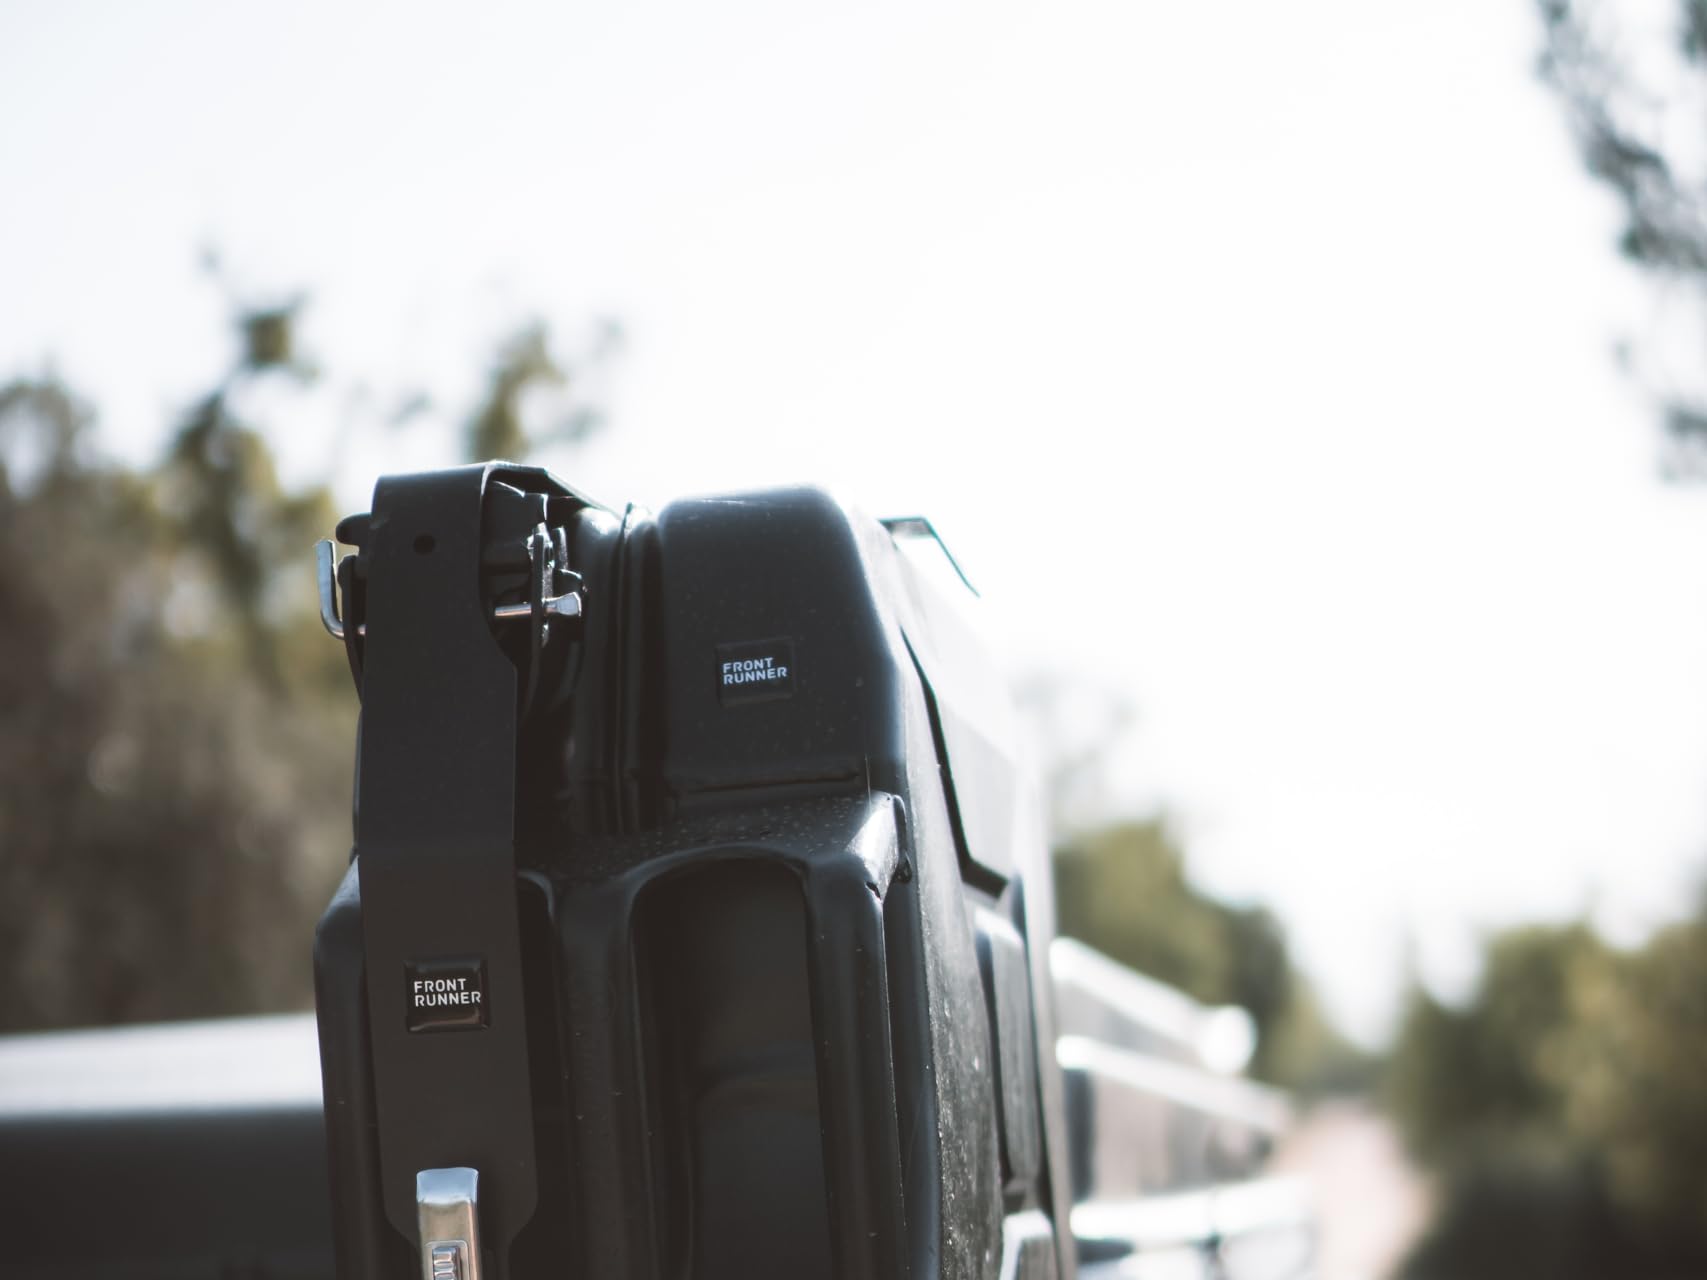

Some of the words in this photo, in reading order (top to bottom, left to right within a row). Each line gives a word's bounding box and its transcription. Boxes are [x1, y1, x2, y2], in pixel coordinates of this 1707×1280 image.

[722, 657, 774, 674] FRONT
[723, 666, 788, 685] RUNNER
[414, 978, 467, 994] FRONT
[414, 991, 481, 1007] RUNNER
